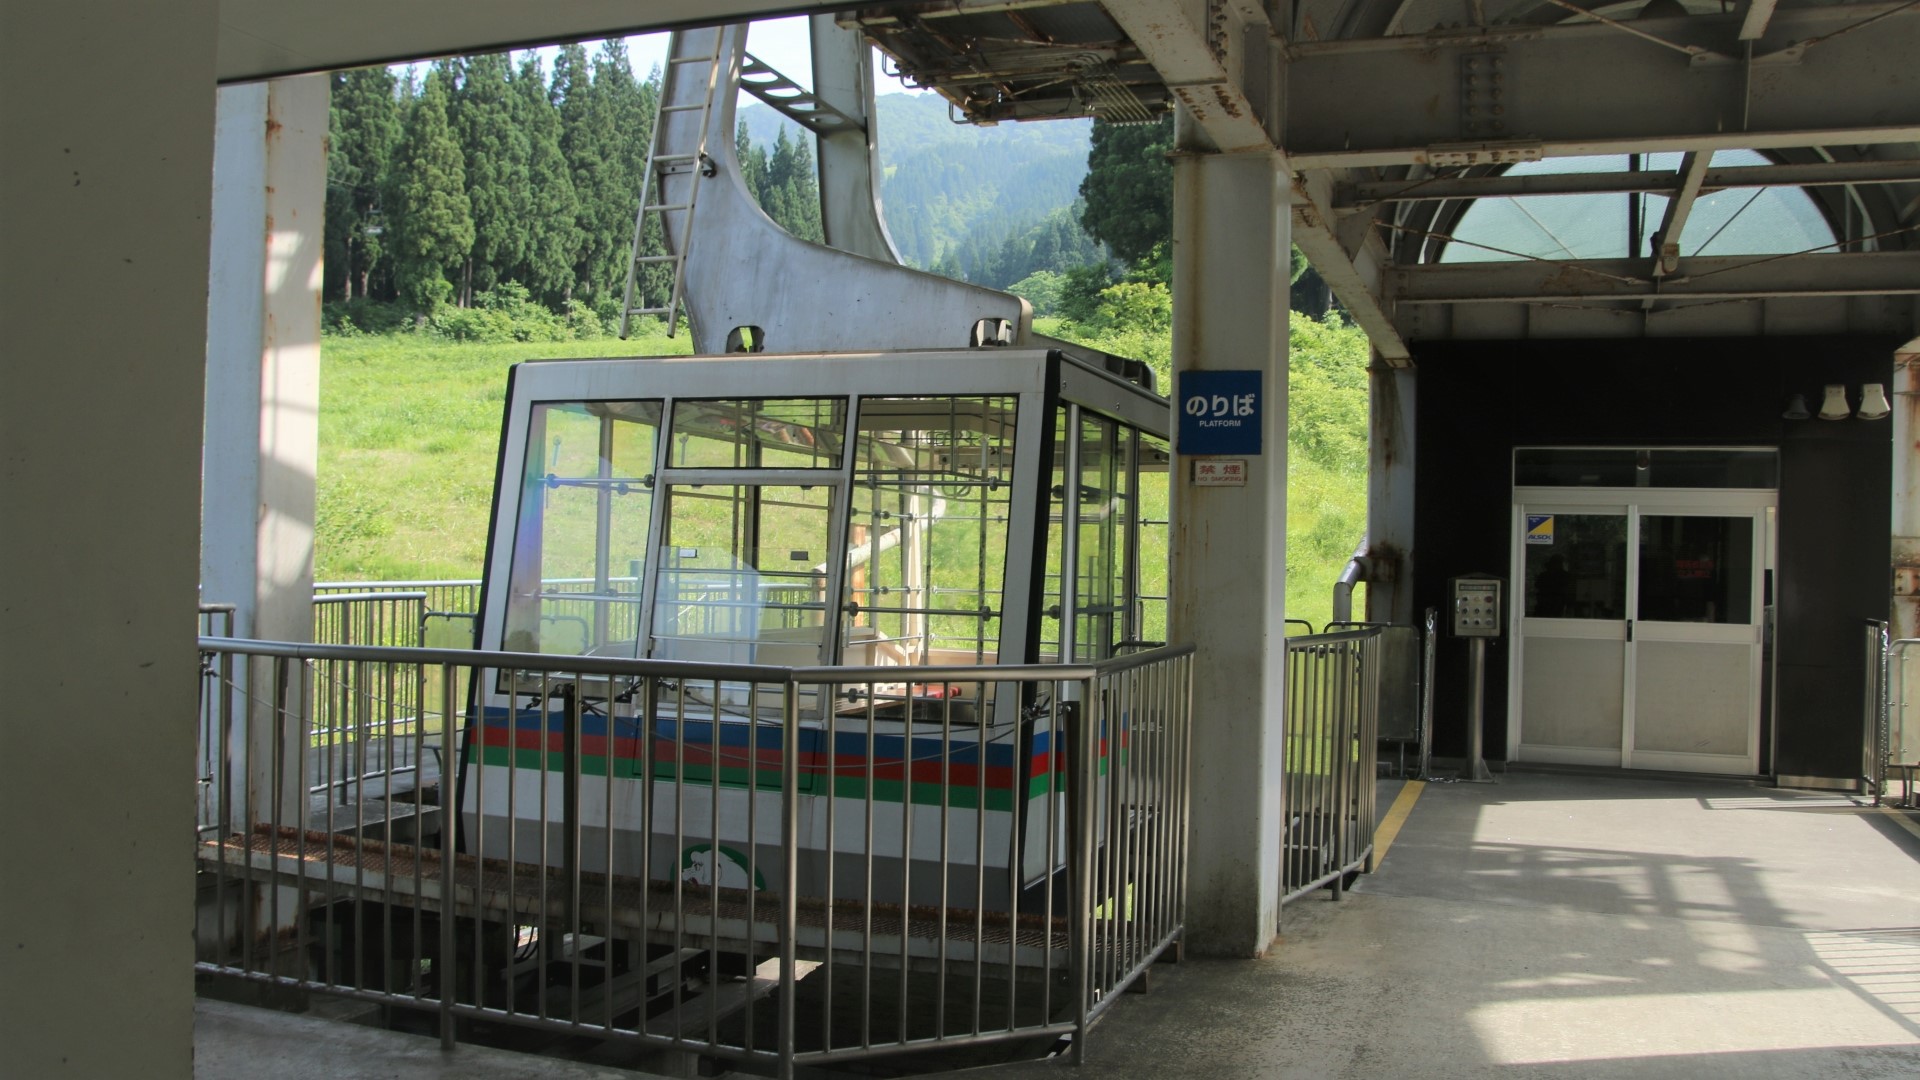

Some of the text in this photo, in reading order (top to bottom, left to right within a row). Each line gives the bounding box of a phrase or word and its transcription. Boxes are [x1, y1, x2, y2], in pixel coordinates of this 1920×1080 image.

[1186, 393, 1255, 416] のりば
[1199, 464, 1241, 475] 禁煙
